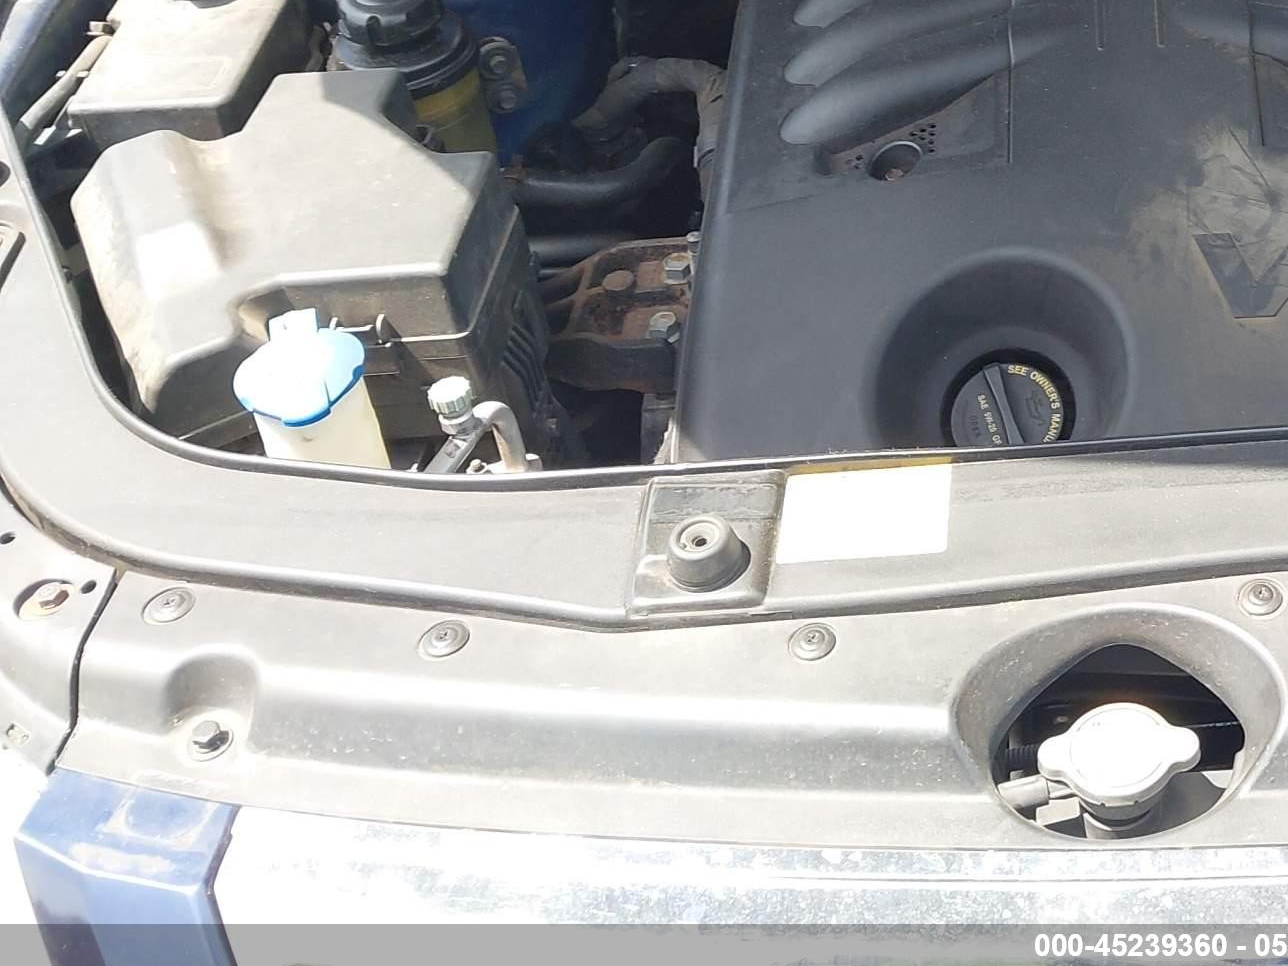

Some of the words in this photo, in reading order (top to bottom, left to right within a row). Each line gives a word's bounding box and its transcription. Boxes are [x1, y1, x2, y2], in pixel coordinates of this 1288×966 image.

[1007, 364, 1029, 377] SEE
[1029, 370, 1061, 410] OWNER'S
[1042, 413, 1062, 443] MANU
